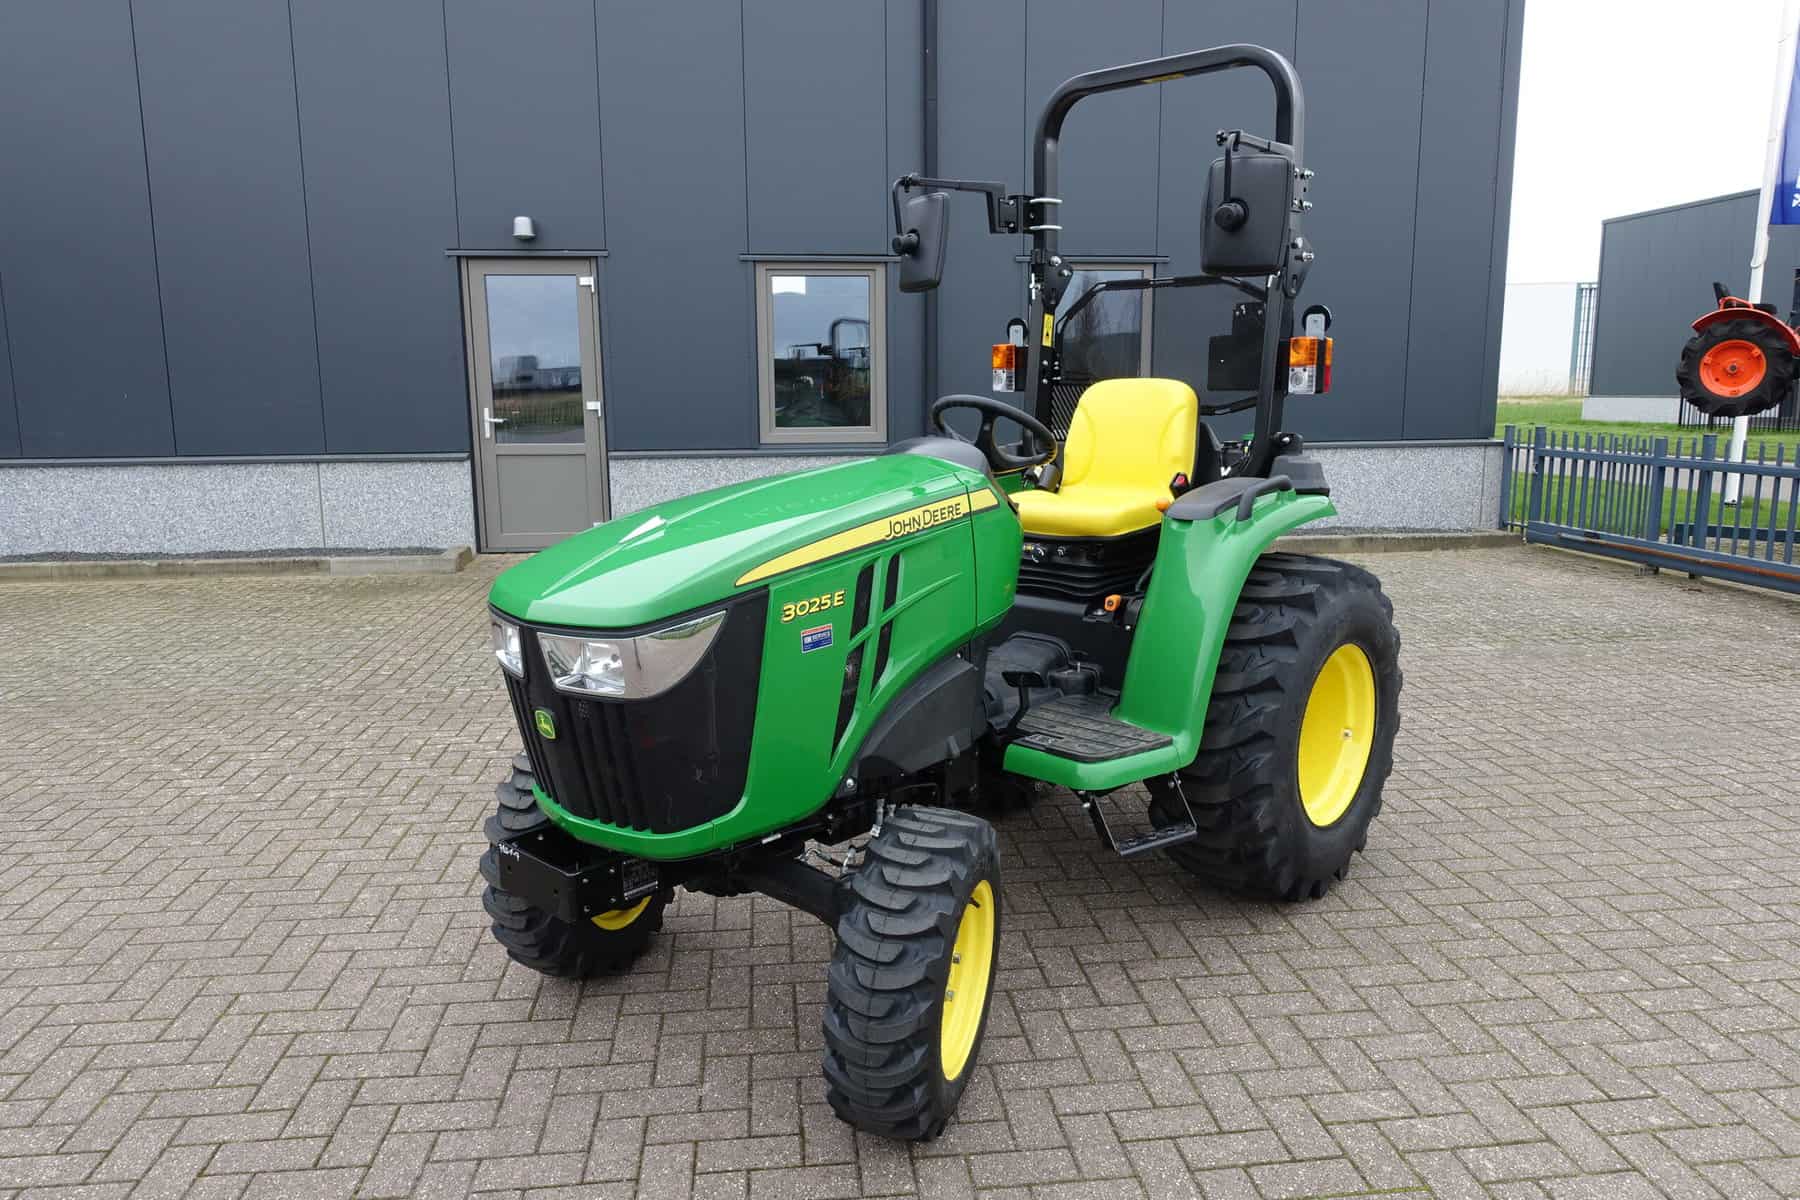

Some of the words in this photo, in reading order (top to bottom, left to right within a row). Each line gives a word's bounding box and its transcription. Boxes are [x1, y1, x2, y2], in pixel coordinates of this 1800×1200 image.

[885, 514, 921, 538] JOHN
[922, 502, 962, 526] DEERE
[782, 590, 846, 622] 3025E
